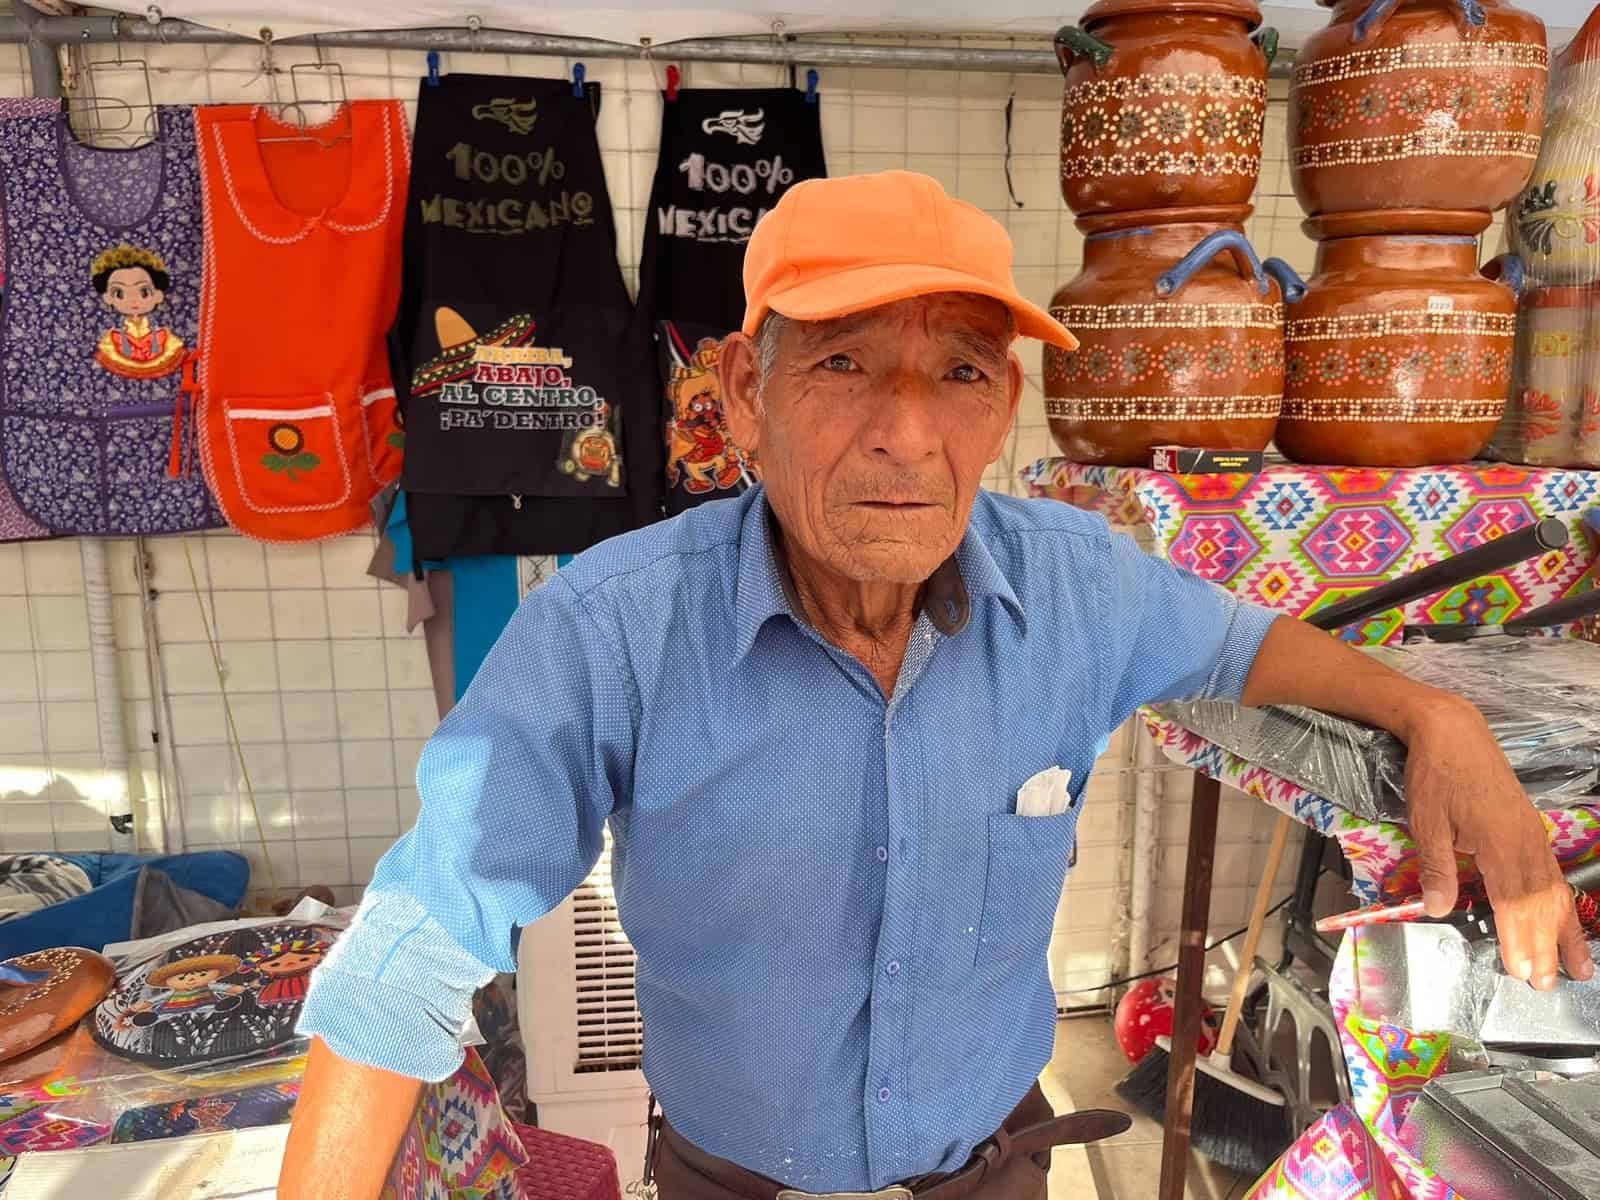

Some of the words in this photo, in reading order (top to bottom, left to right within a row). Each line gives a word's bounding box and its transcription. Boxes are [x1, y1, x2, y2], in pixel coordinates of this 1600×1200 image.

[446, 142, 566, 185] 100%
[678, 152, 794, 195] 100%
[420, 191, 593, 231] MEXICANO
[657, 205, 770, 239] MEXIC
[475, 365, 572, 387] ABAJO,
[440, 382, 479, 405] AL
[485, 386, 606, 409] CENTRO,
